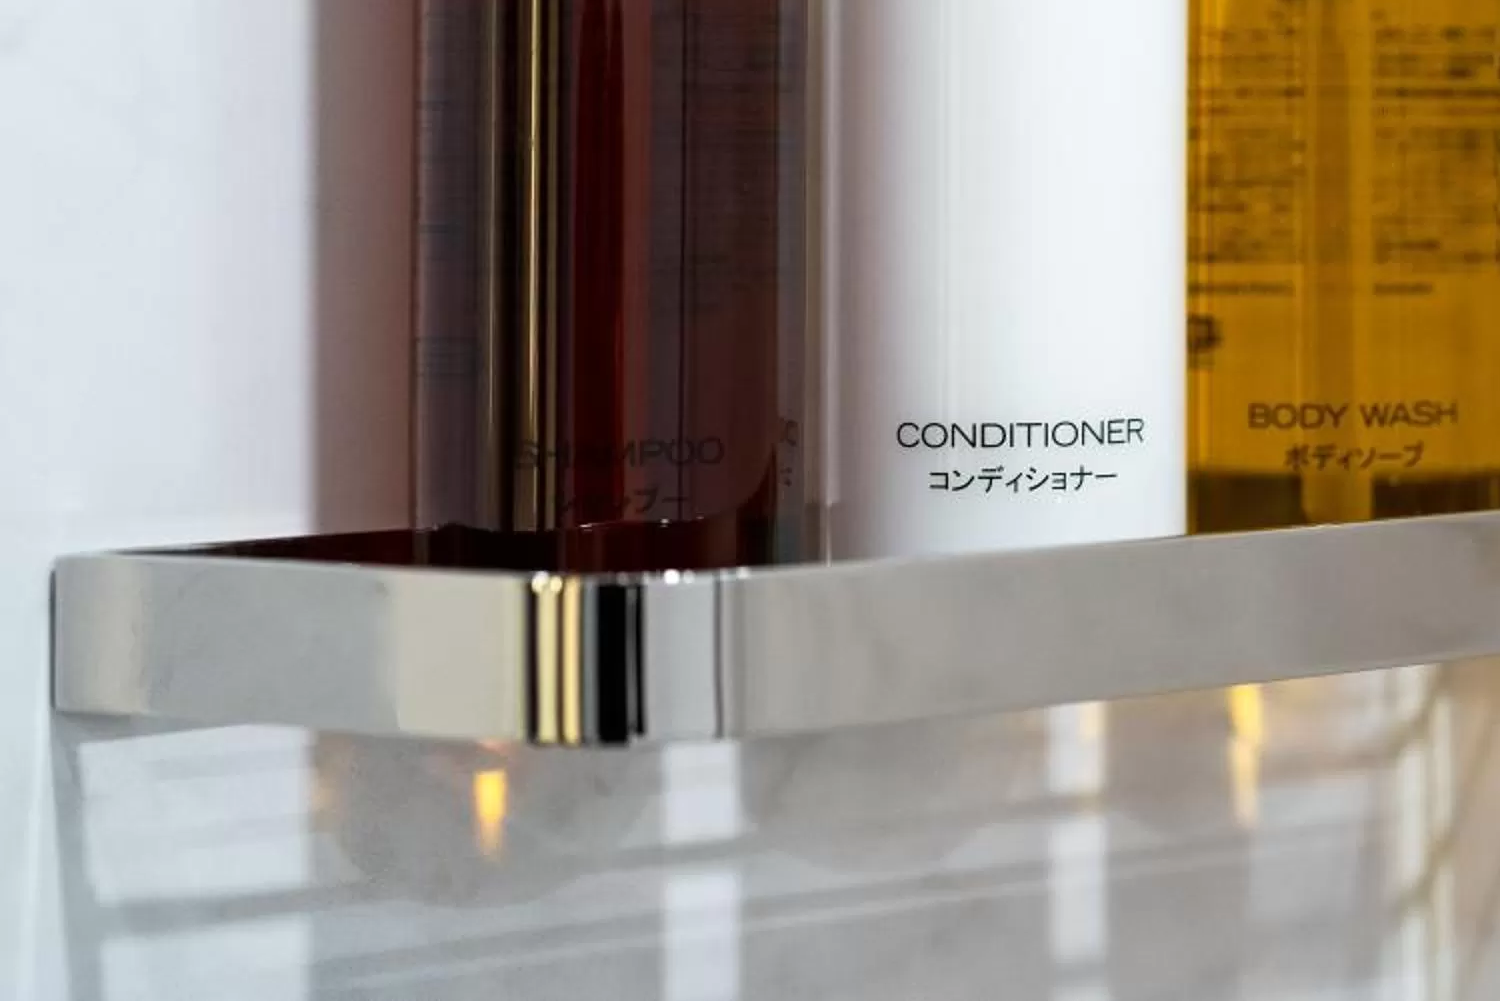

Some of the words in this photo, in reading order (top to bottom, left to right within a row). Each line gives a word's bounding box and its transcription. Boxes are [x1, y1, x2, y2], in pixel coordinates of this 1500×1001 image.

[1247, 402, 1349, 430] BODY
[1360, 400, 1458, 429] WASH
[896, 418, 1145, 449] CONDITIONER
[514, 437, 724, 468] SHMPOO
[929, 465, 1118, 493] コンディショナー
